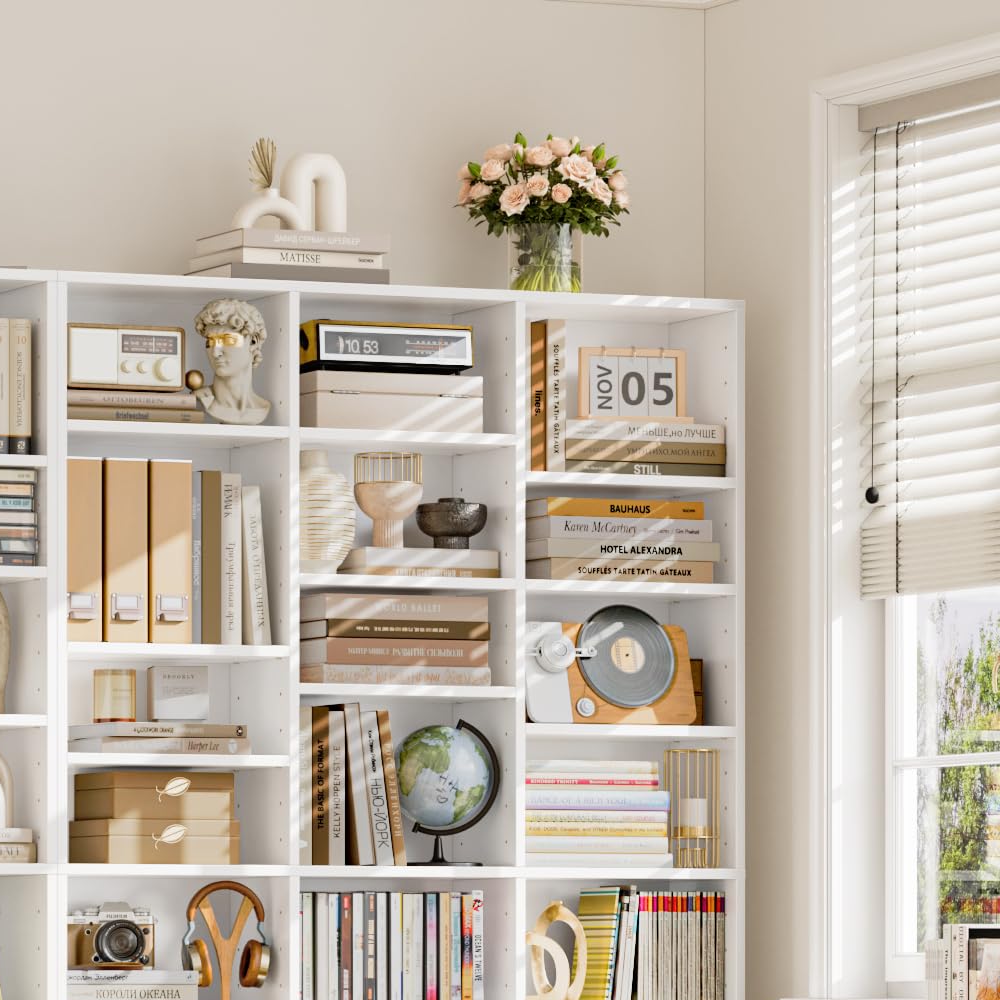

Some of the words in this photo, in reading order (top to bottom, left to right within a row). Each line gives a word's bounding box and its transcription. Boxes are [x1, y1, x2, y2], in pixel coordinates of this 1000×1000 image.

[280, 252, 320, 264] MATISSE
[597, 365, 613, 409] NOV
[535, 390, 543, 416] lines.
[684, 430, 717, 439] ЛУЧШЕ
[634, 464, 661, 475] STILL
[610, 505, 650, 514] BAUHAUS
[564, 520, 588, 531] Karen
[592, 521, 637, 535] McCartney
[600, 545, 628, 554] HOTEL
[630, 546, 682, 555] ALEXANDRA
[187, 741, 207, 752] Harper
[209, 742, 220, 751] Lee
[318, 775, 324, 786] OF
[369, 778, 390, 848] НЬЮ-ЙОРК
[959, 972, 964, 983] BY
[95, 989, 137, 999] КОРОЛИ
[139, 989, 181, 999] ОКЕАНА
